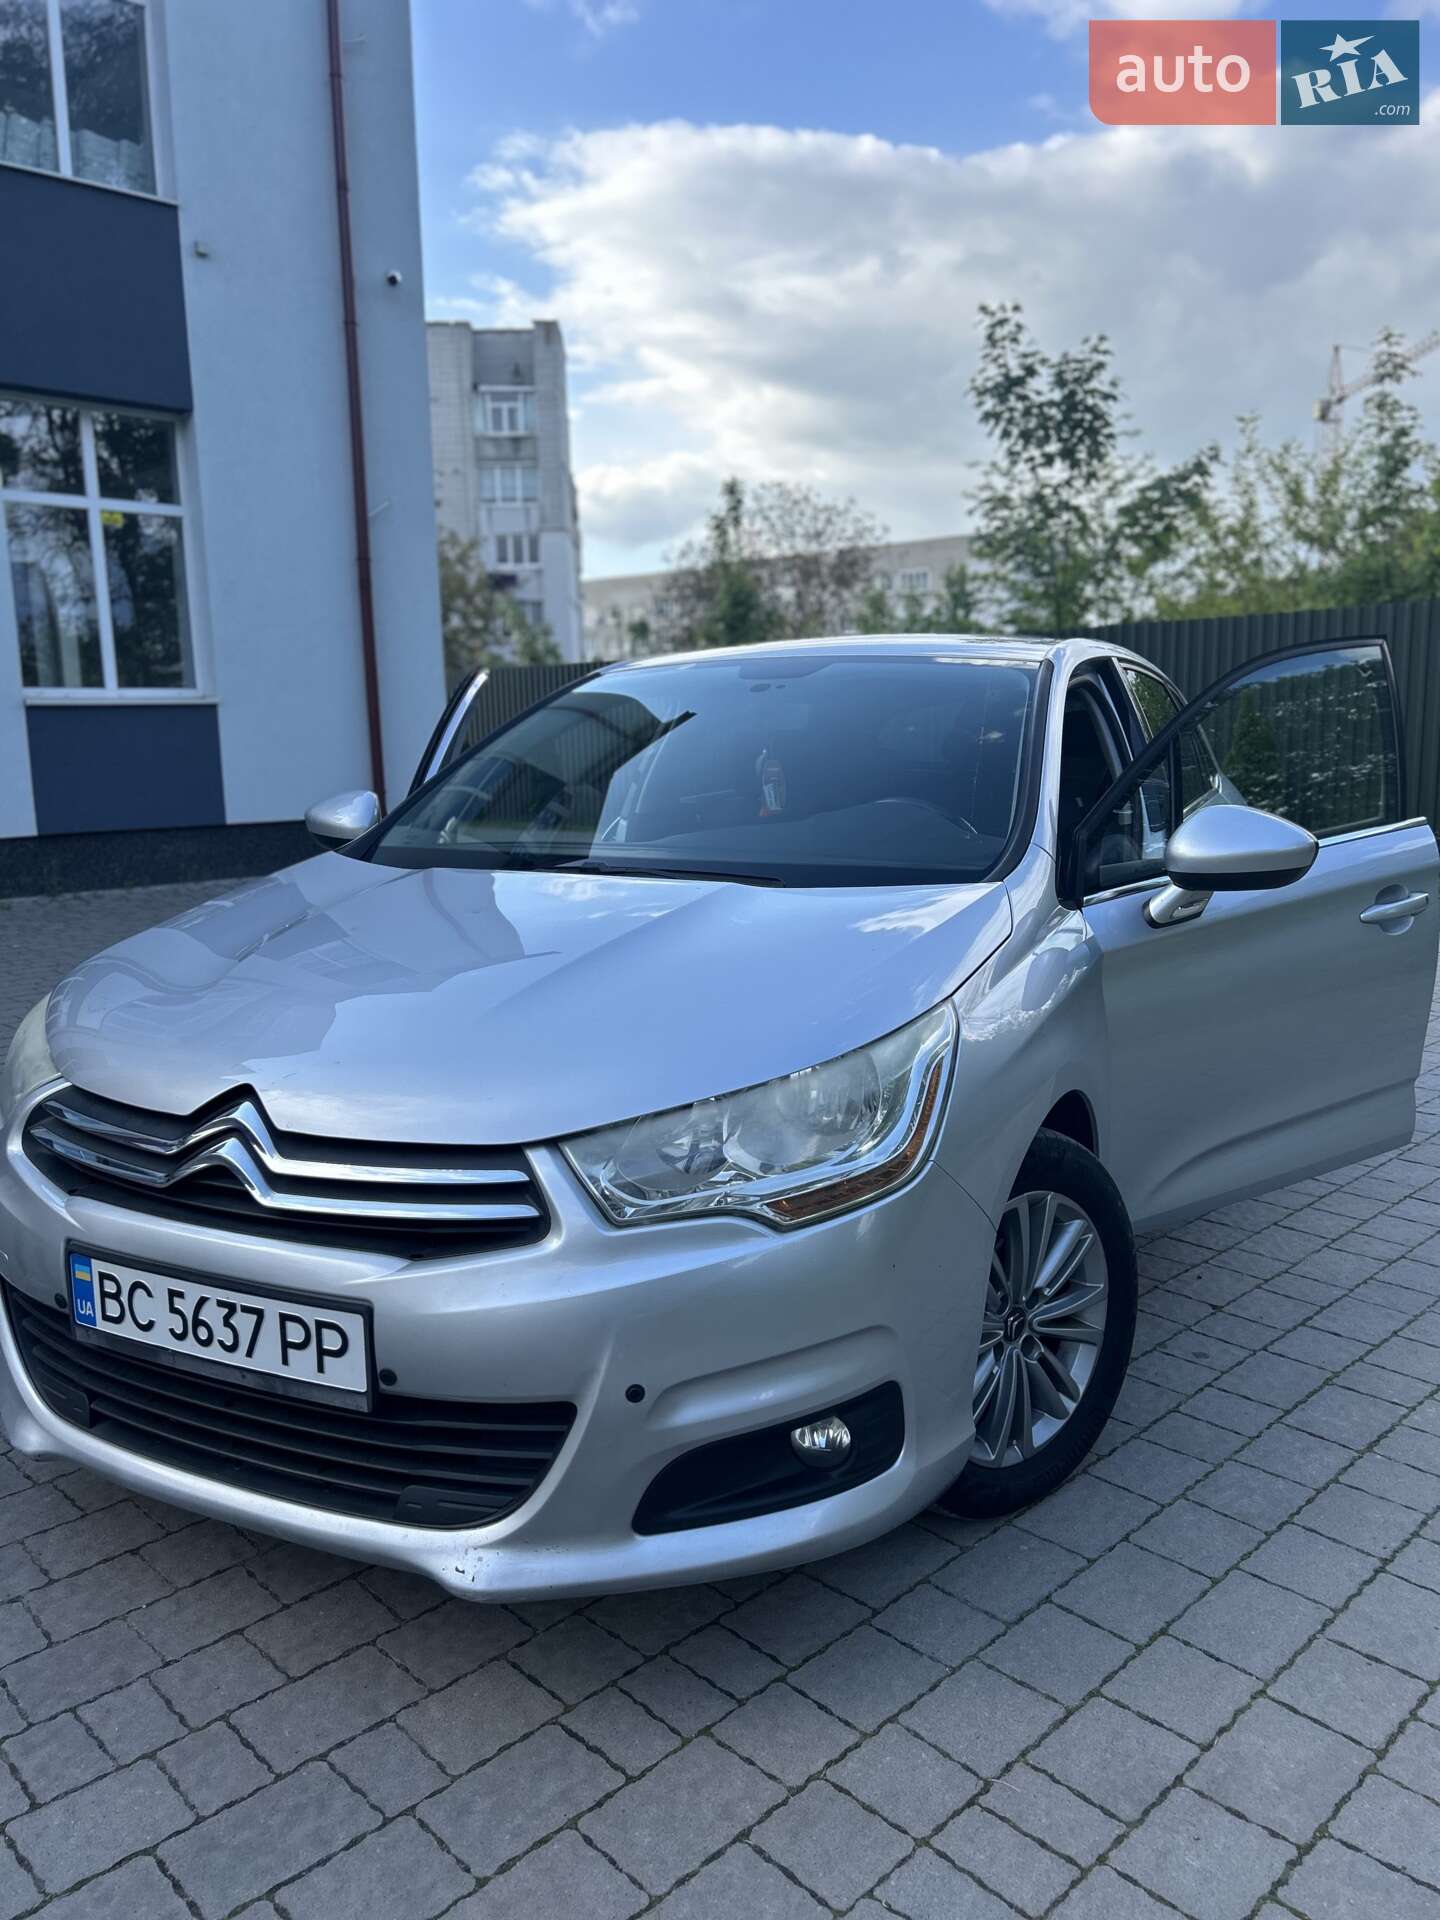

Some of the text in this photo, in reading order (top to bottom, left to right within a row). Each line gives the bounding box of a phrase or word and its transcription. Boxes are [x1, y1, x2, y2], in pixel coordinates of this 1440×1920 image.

[77, 1298, 94, 1318] UA
[97, 1270, 349, 1374] BC 5637 PP
